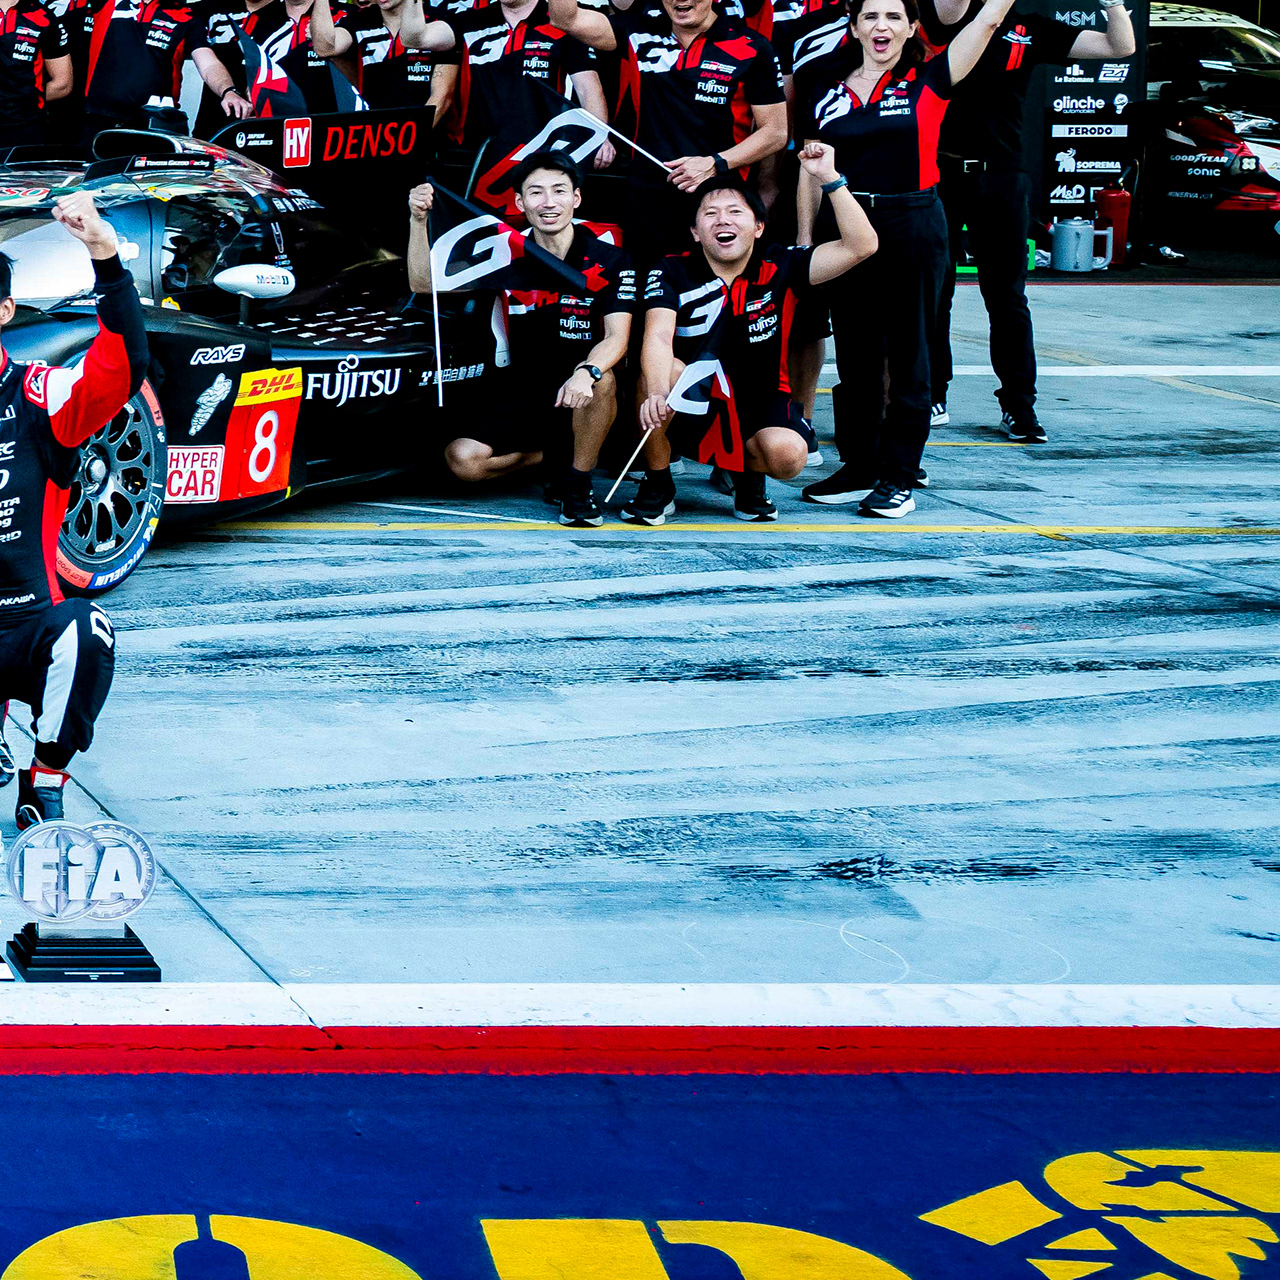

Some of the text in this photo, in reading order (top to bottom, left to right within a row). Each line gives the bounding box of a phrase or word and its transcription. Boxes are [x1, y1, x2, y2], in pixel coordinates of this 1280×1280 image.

[1056, 11, 1096, 26] MSM
[697, 79, 728, 94] FUJITSU
[880, 96, 909, 108] FUJITSU
[1053, 96, 1105, 112] glinche
[323, 120, 417, 162] DENSO
[1068, 127, 1113, 135] FERODO
[285, 127, 310, 159] HY
[1076, 161, 1121, 169] SOPREMA
[1050, 184, 1085, 199] M&D
[560, 315, 590, 330] FUJITSU
[190, 344, 245, 365] RAYS
[250, 373, 297, 397] DHL
[305, 354, 401, 407] FUJITSU
[248, 410, 279, 482] 8
[168, 448, 218, 468] HYPER
[166, 468, 214, 497] CAR
[94, 541, 145, 587] MICHELIN
[23, 844, 144, 901] FIA
